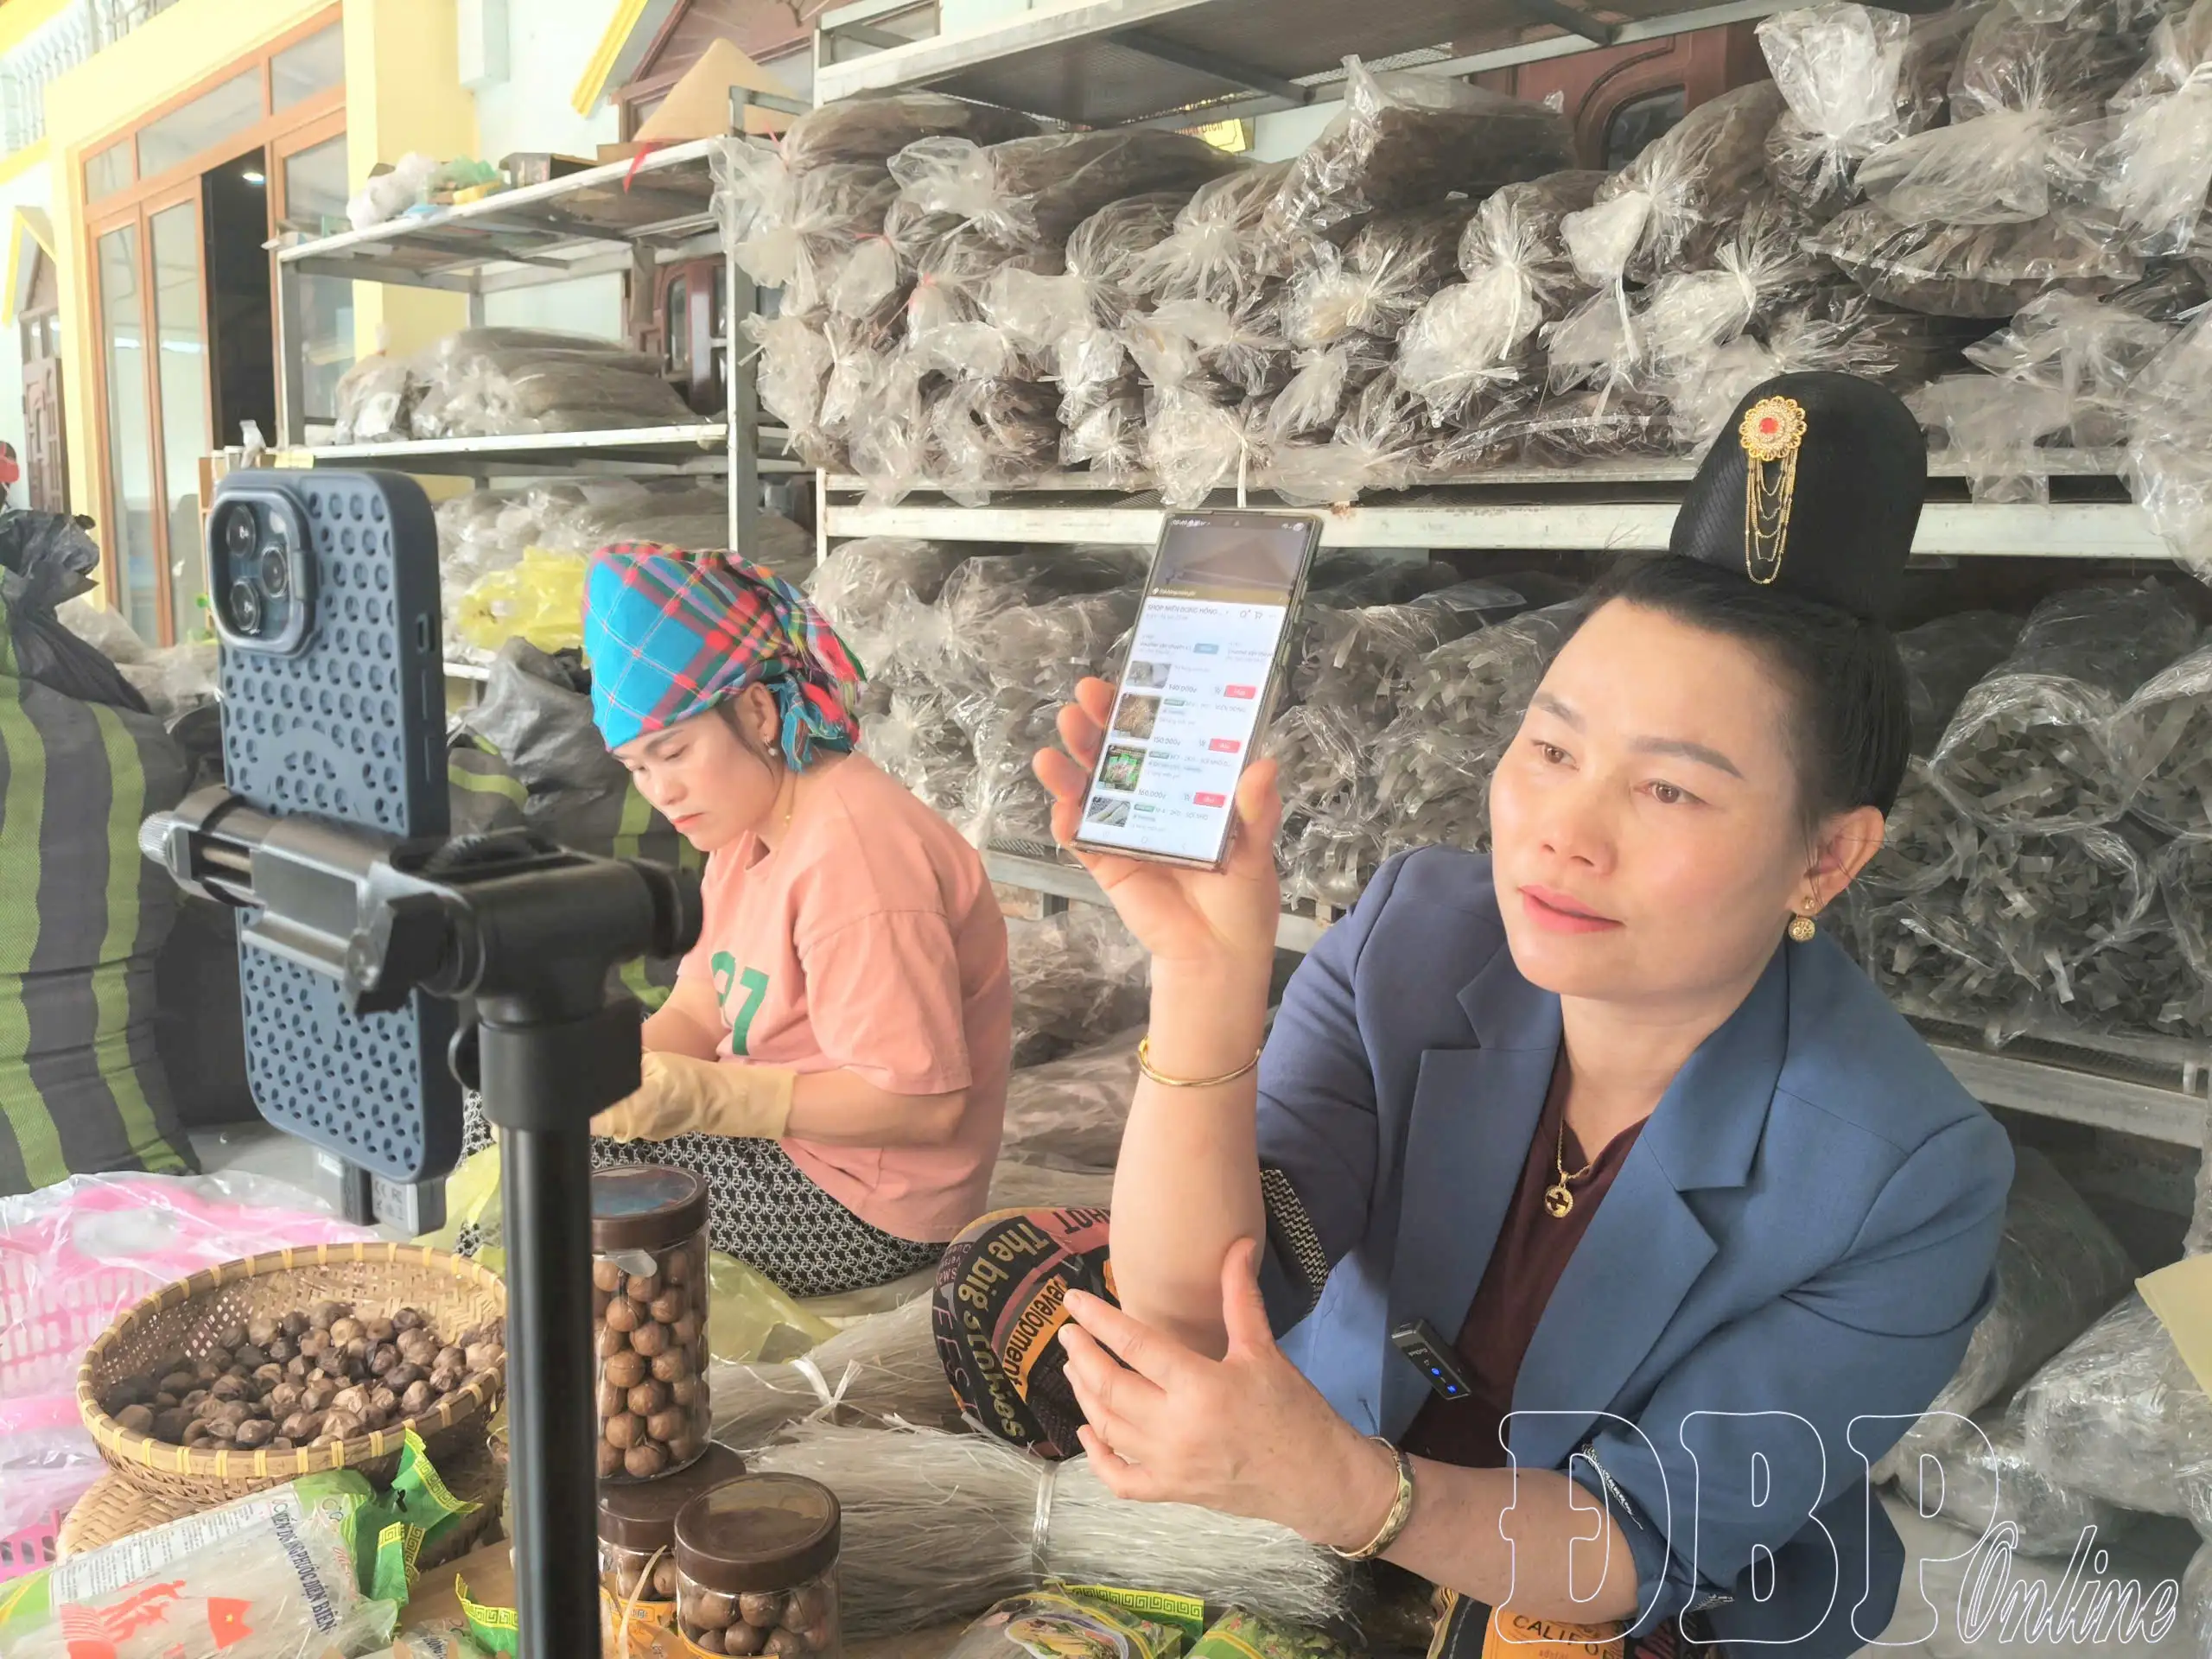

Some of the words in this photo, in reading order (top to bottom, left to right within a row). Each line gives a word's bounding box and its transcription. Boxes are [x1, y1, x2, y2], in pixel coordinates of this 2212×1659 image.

[988, 1223, 1049, 1262] The
[957, 1255, 1009, 1312] big
[312, 1600, 339, 1633] BIÊN
